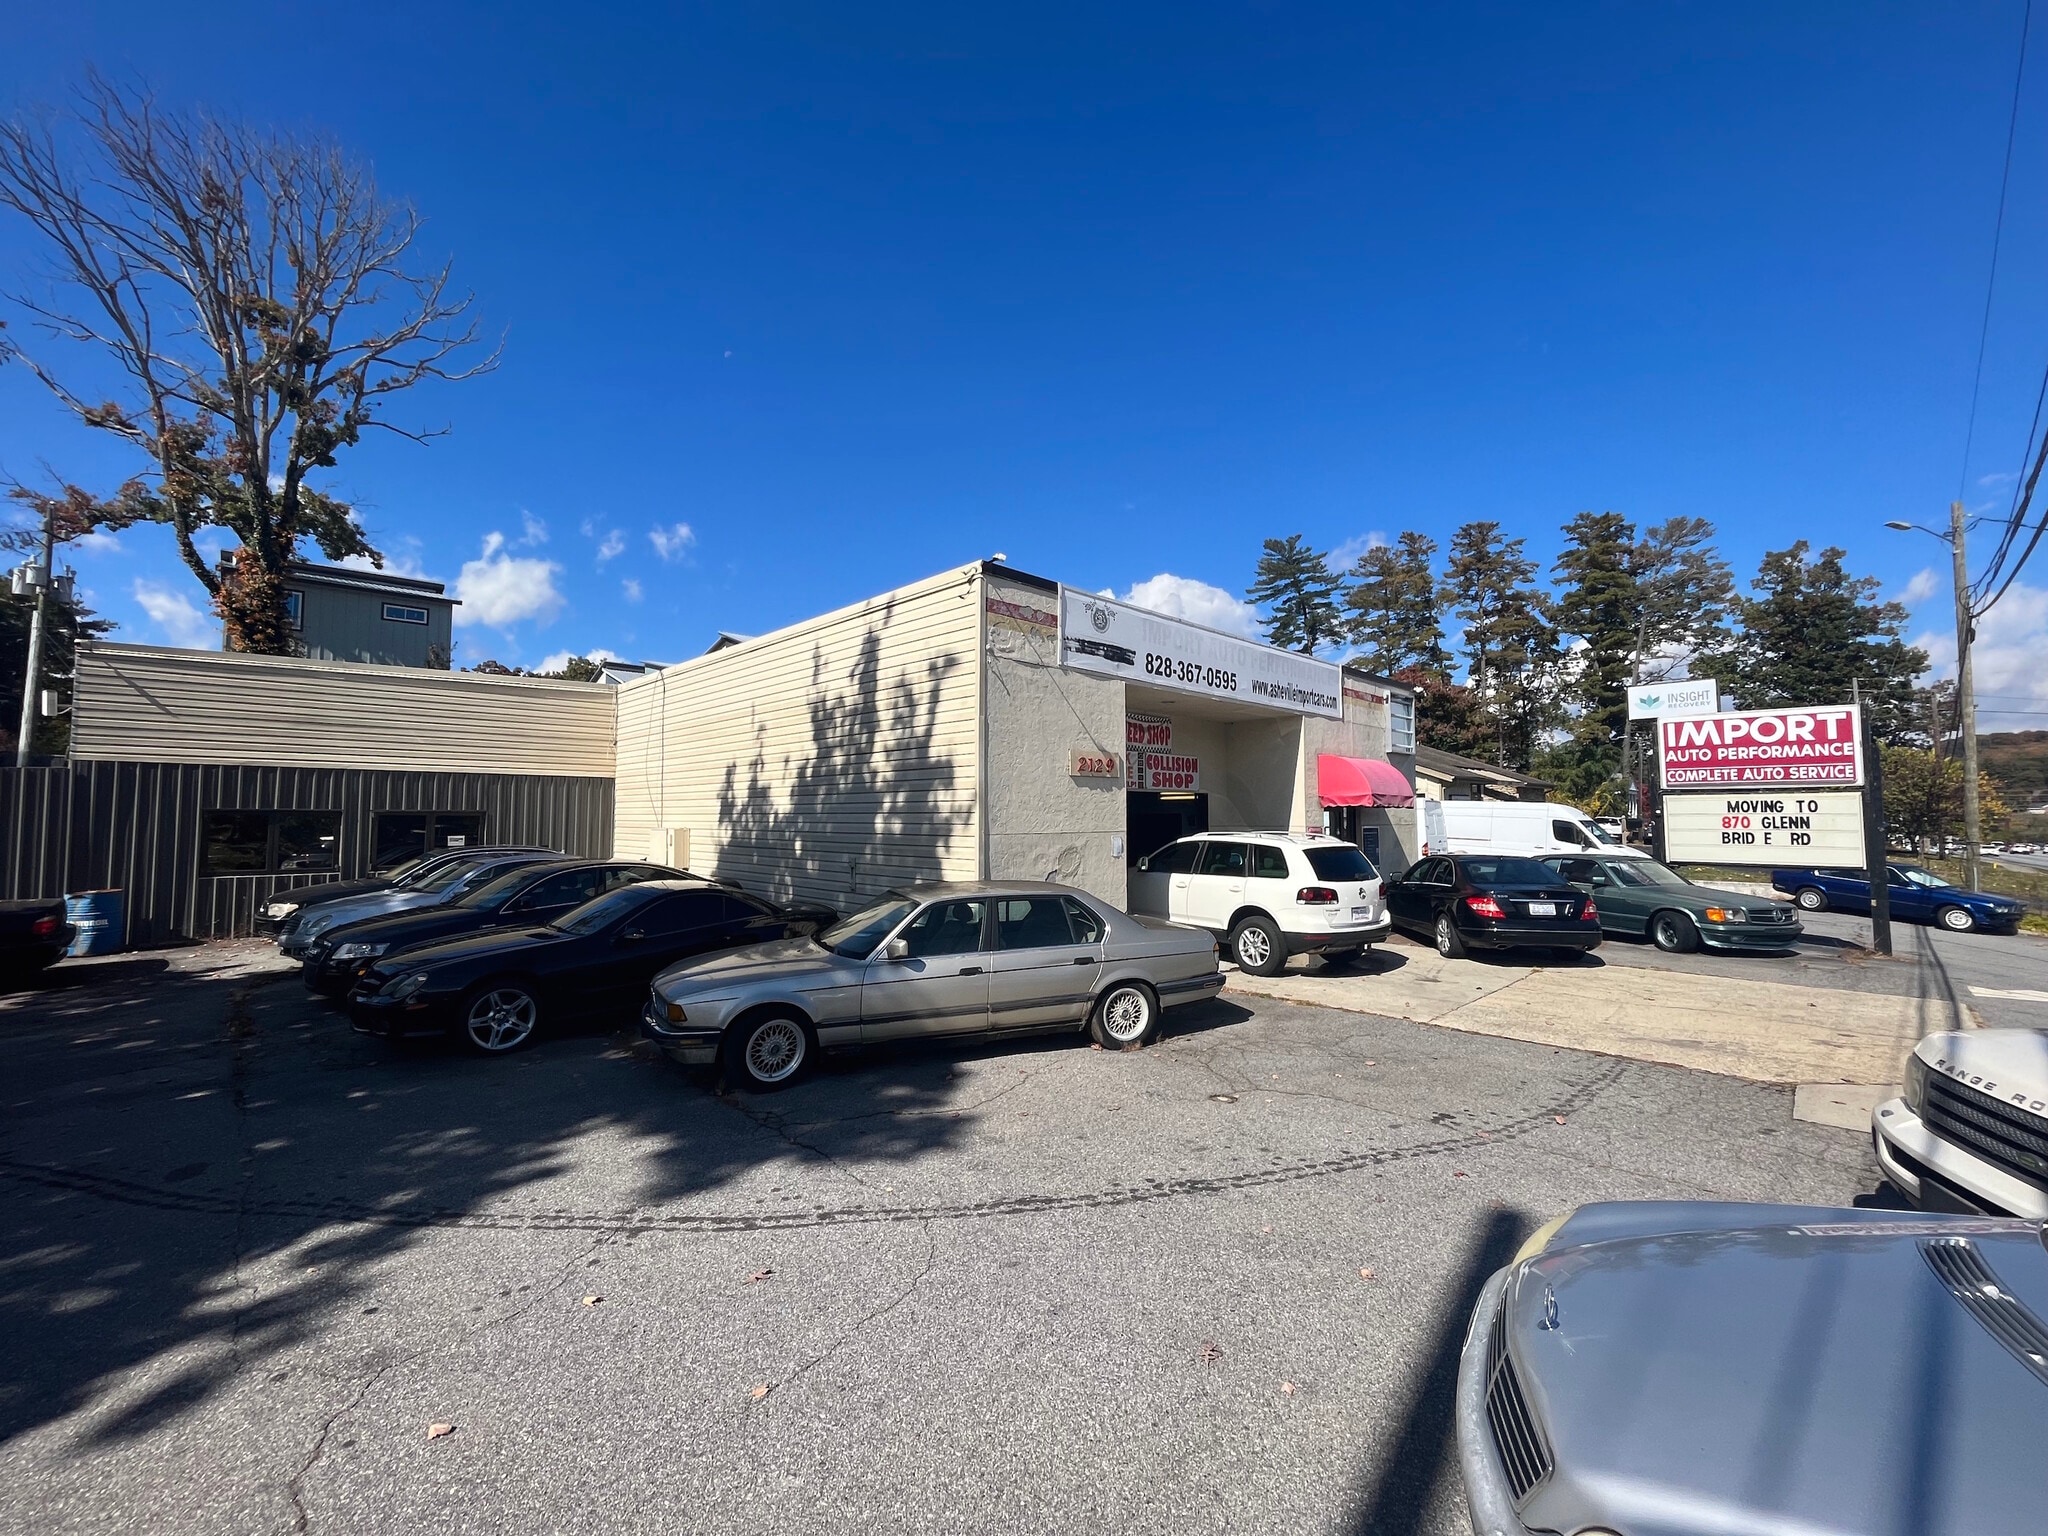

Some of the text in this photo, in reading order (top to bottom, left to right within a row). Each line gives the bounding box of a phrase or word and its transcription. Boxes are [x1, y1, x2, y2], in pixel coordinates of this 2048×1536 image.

[1145, 653, 1237, 692] 828-367-0595
[1251, 679, 1338, 710] www.ashevilleimportcars.com
[1667, 690, 1710, 704] INSIGHT
[1668, 700, 1711, 709] RECOVERY
[1147, 724, 1171, 746] SHOP
[1666, 712, 1847, 748] IMPORT
[1666, 742, 1854, 763] AUTO PERFORMANCE
[1077, 757, 1115, 773] 2129
[1146, 754, 1198, 773] COLLISION
[1151, 772, 1194, 789] SHOP
[1667, 765, 1854, 783] COMPLETE AUTO SERVICE
[1726, 800, 1819, 813] MOVING TO
[1721, 816, 1811, 829] 870 GLENN
[1790, 832, 1811, 846] RD
[1935, 1059, 1997, 1091] RANGE
